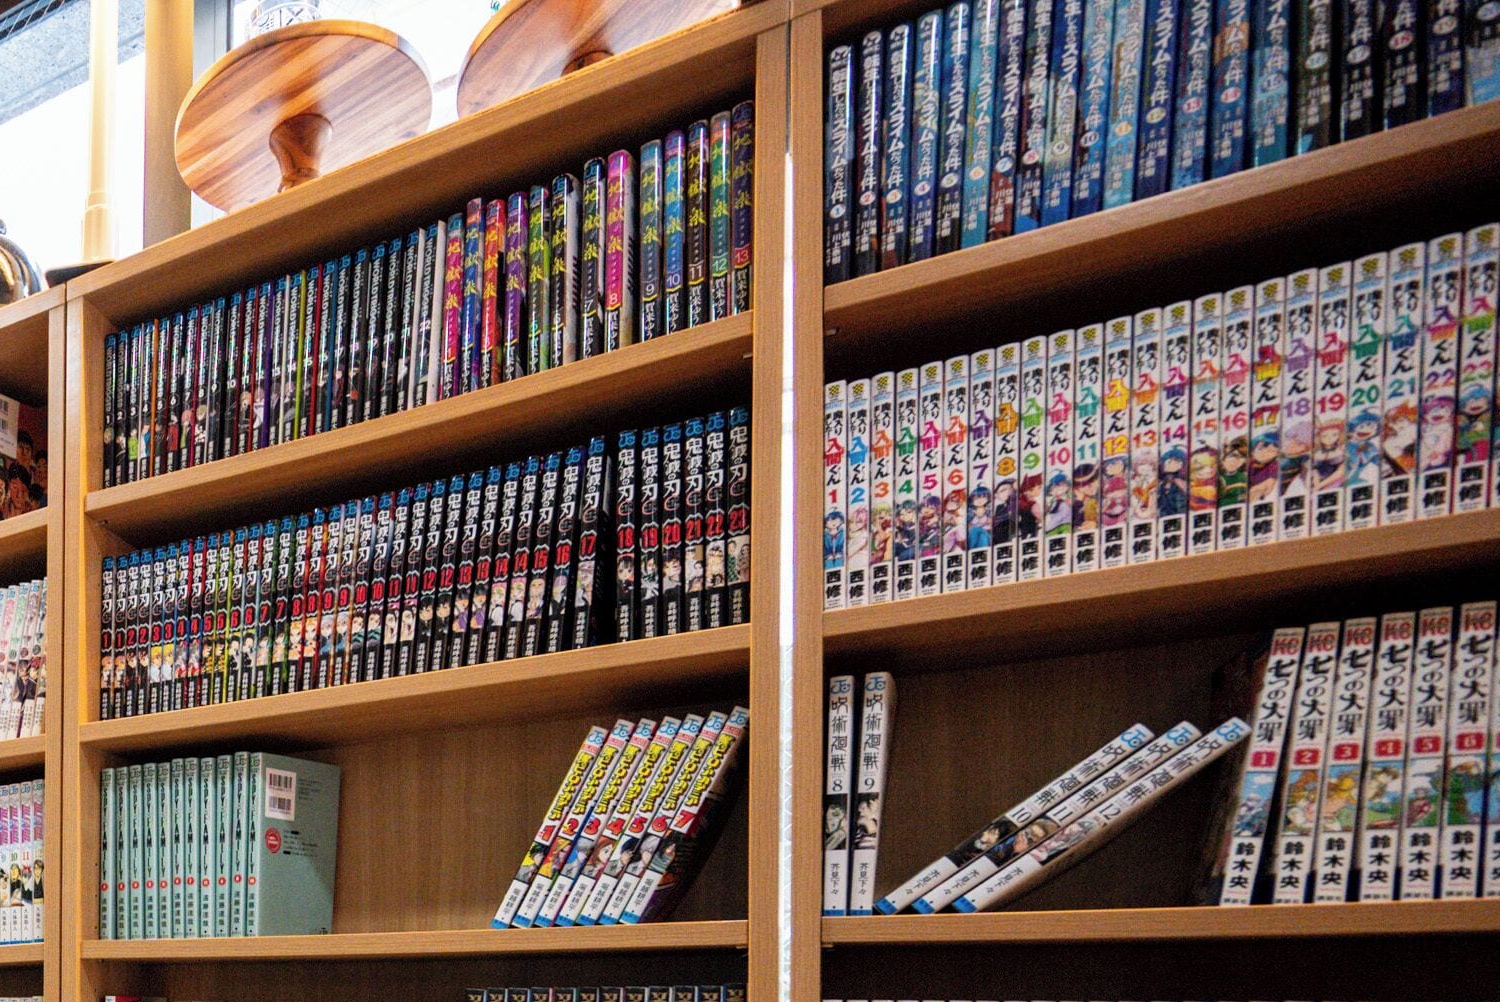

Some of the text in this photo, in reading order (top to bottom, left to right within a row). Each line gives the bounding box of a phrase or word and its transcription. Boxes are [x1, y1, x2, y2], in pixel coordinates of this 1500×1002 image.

[713, 258, 727, 270] 12
[735, 250, 749, 263] 13
[667, 274, 680, 286] 10
[690, 267, 702, 279] 11
[1352, 386, 1378, 405] 20
[1388, 378, 1415, 398] 21
[1318, 392, 1344, 412] 19
[1223, 414, 1247, 431] 16
[1163, 425, 1186, 442] 14
[1023, 452, 1039, 469] 9
[1049, 448, 1070, 464] 10
[664, 443, 681, 541] 鬼滅の刃 20
[706, 432, 724, 535] 鬼滅の刃 22
[923, 476, 938, 490] 5
[617, 449, 635, 548] 鬼滅の刃 18
[828, 491, 838, 503] 1
[851, 490, 865, 504] 2
[1077, 443, 1097, 563] 11 西修
[686, 518, 701, 539] 21
[972, 465, 988, 581] 7 西修
[581, 535, 595, 555] 17
[898, 480, 913, 592] 4 西修
[826, 571, 841, 599] 西修
[1297, 656, 1332, 742] 七つの大罪
[830, 697, 849, 772] 呪術廻戦
[863, 694, 884, 770] 呪術廻戦
[1322, 650, 1371, 884] 七つの大罪 鈴木央
[1408, 639, 1448, 881] 七つの大罪 鈴木央
[1451, 635, 1492, 880] 七つの大罪 鈴木央
[1038, 744, 1126, 805] 呪術廻戦
[1055, 743, 1172, 822] 呪術廻戦 11
[1100, 739, 1222, 820] 呪術廻戦 12
[1229, 659, 1296, 889] 七つの大罪 鈴木央
[833, 779, 842, 792] 8
[864, 778, 874, 791] 9
[628, 817, 647, 833] 5
[651, 815, 670, 832] 6
[674, 810, 697, 829] 7
[1011, 807, 1030, 824] 10
[542, 825, 556, 841] 1
[563, 819, 579, 835] 2
[585, 819, 600, 835] 3
[607, 819, 625, 835] 4
